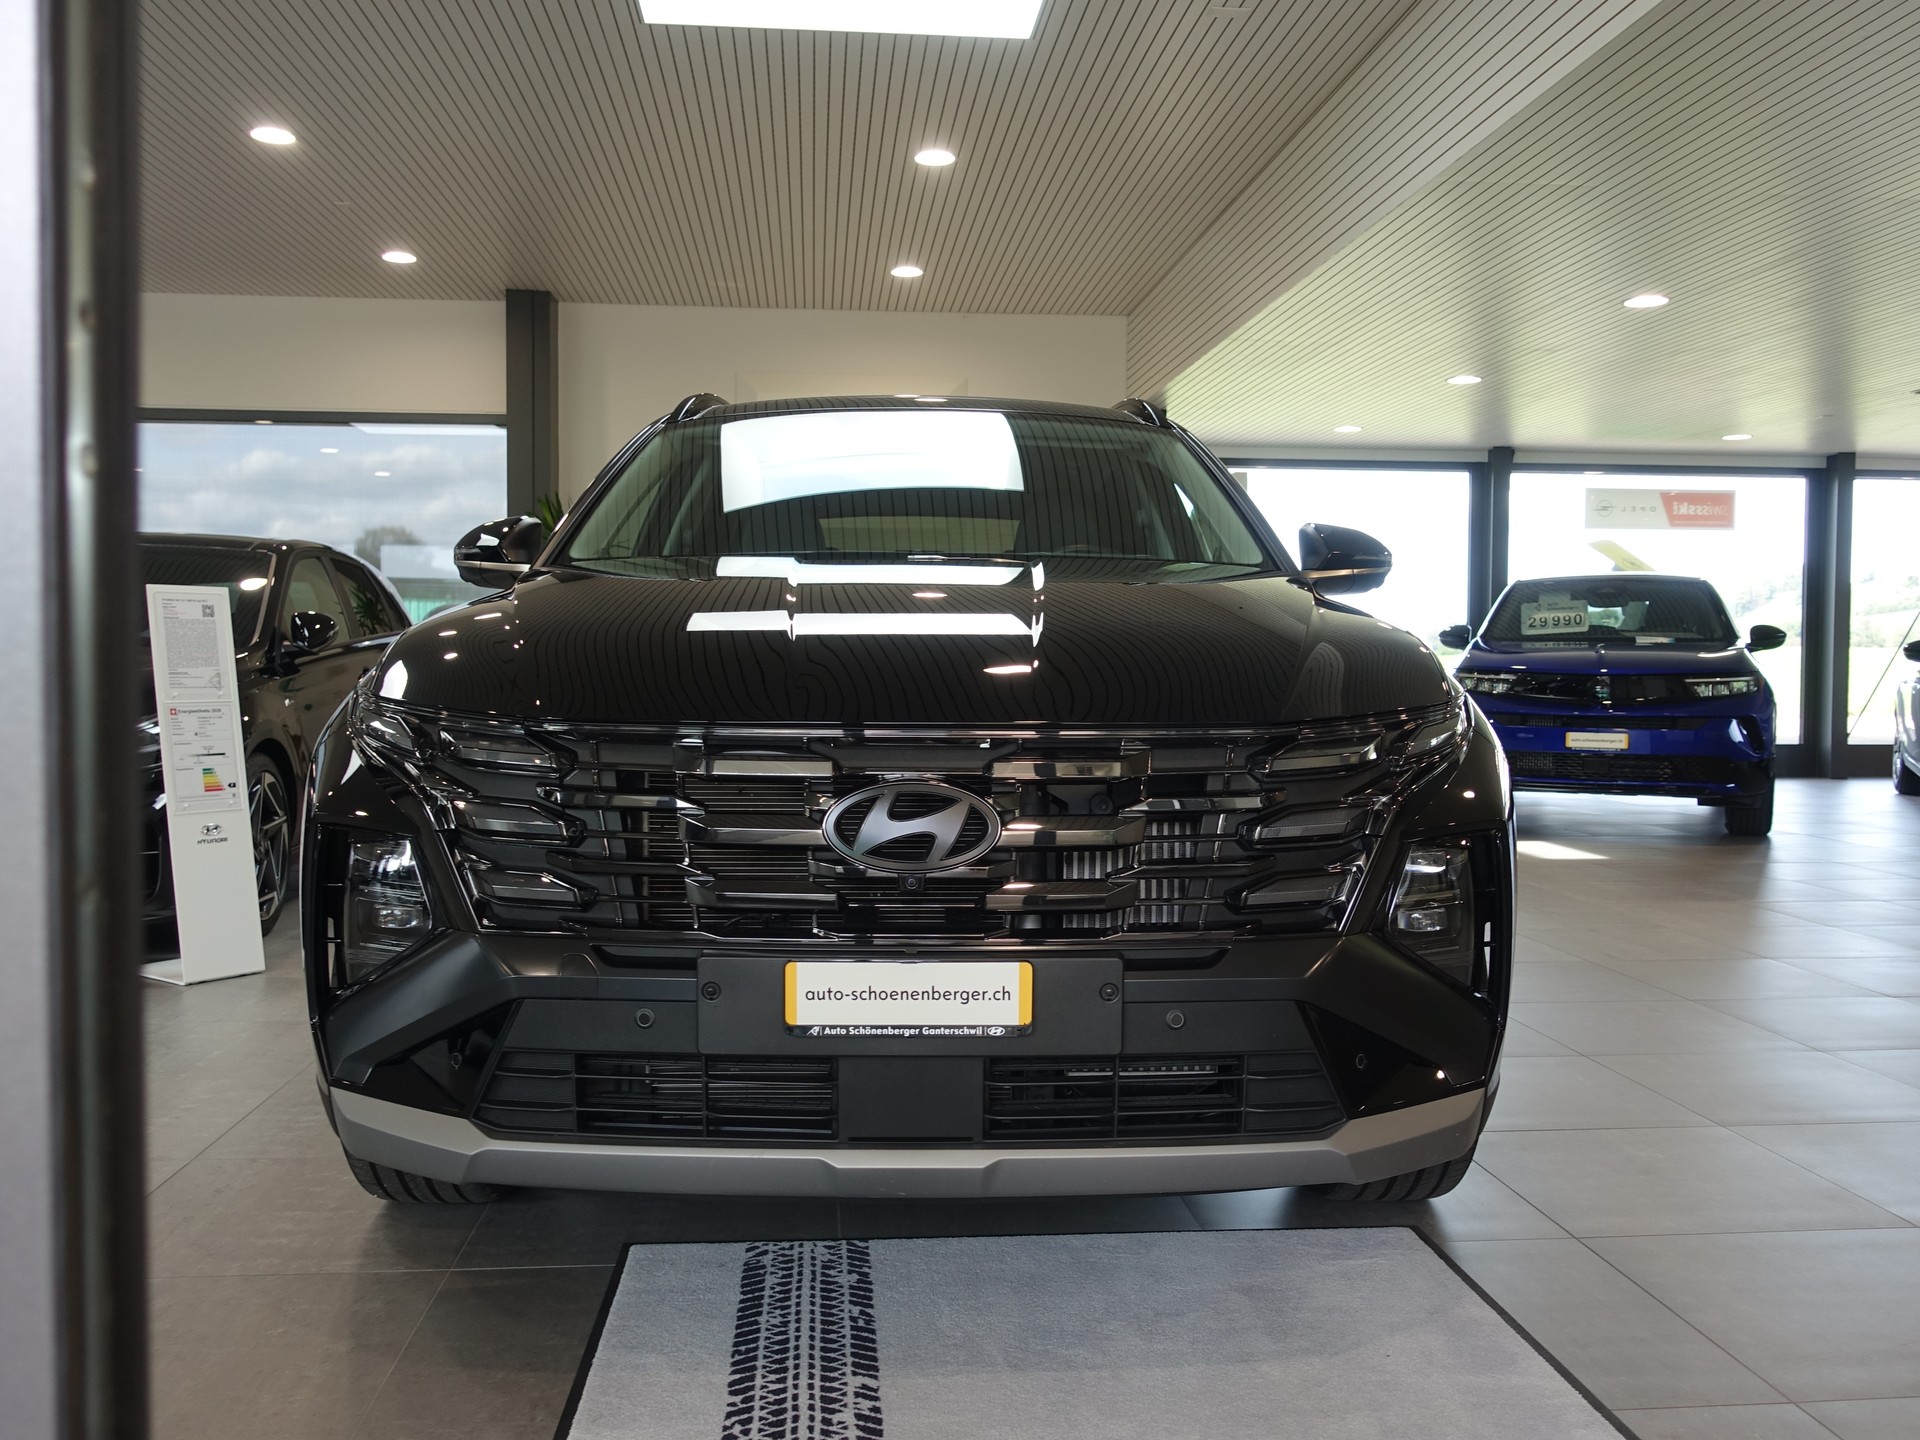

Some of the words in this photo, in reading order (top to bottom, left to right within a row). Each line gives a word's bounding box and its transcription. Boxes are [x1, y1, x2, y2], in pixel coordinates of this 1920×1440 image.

[197, 837, 228, 845] HYUNDAI
[805, 985, 1011, 1004] auto-schoenenberger.ch
[824, 1026, 847, 1035] Auto
[849, 1026, 920, 1037] Schönenberger
[922, 1026, 983, 1035] Ganterschwil
